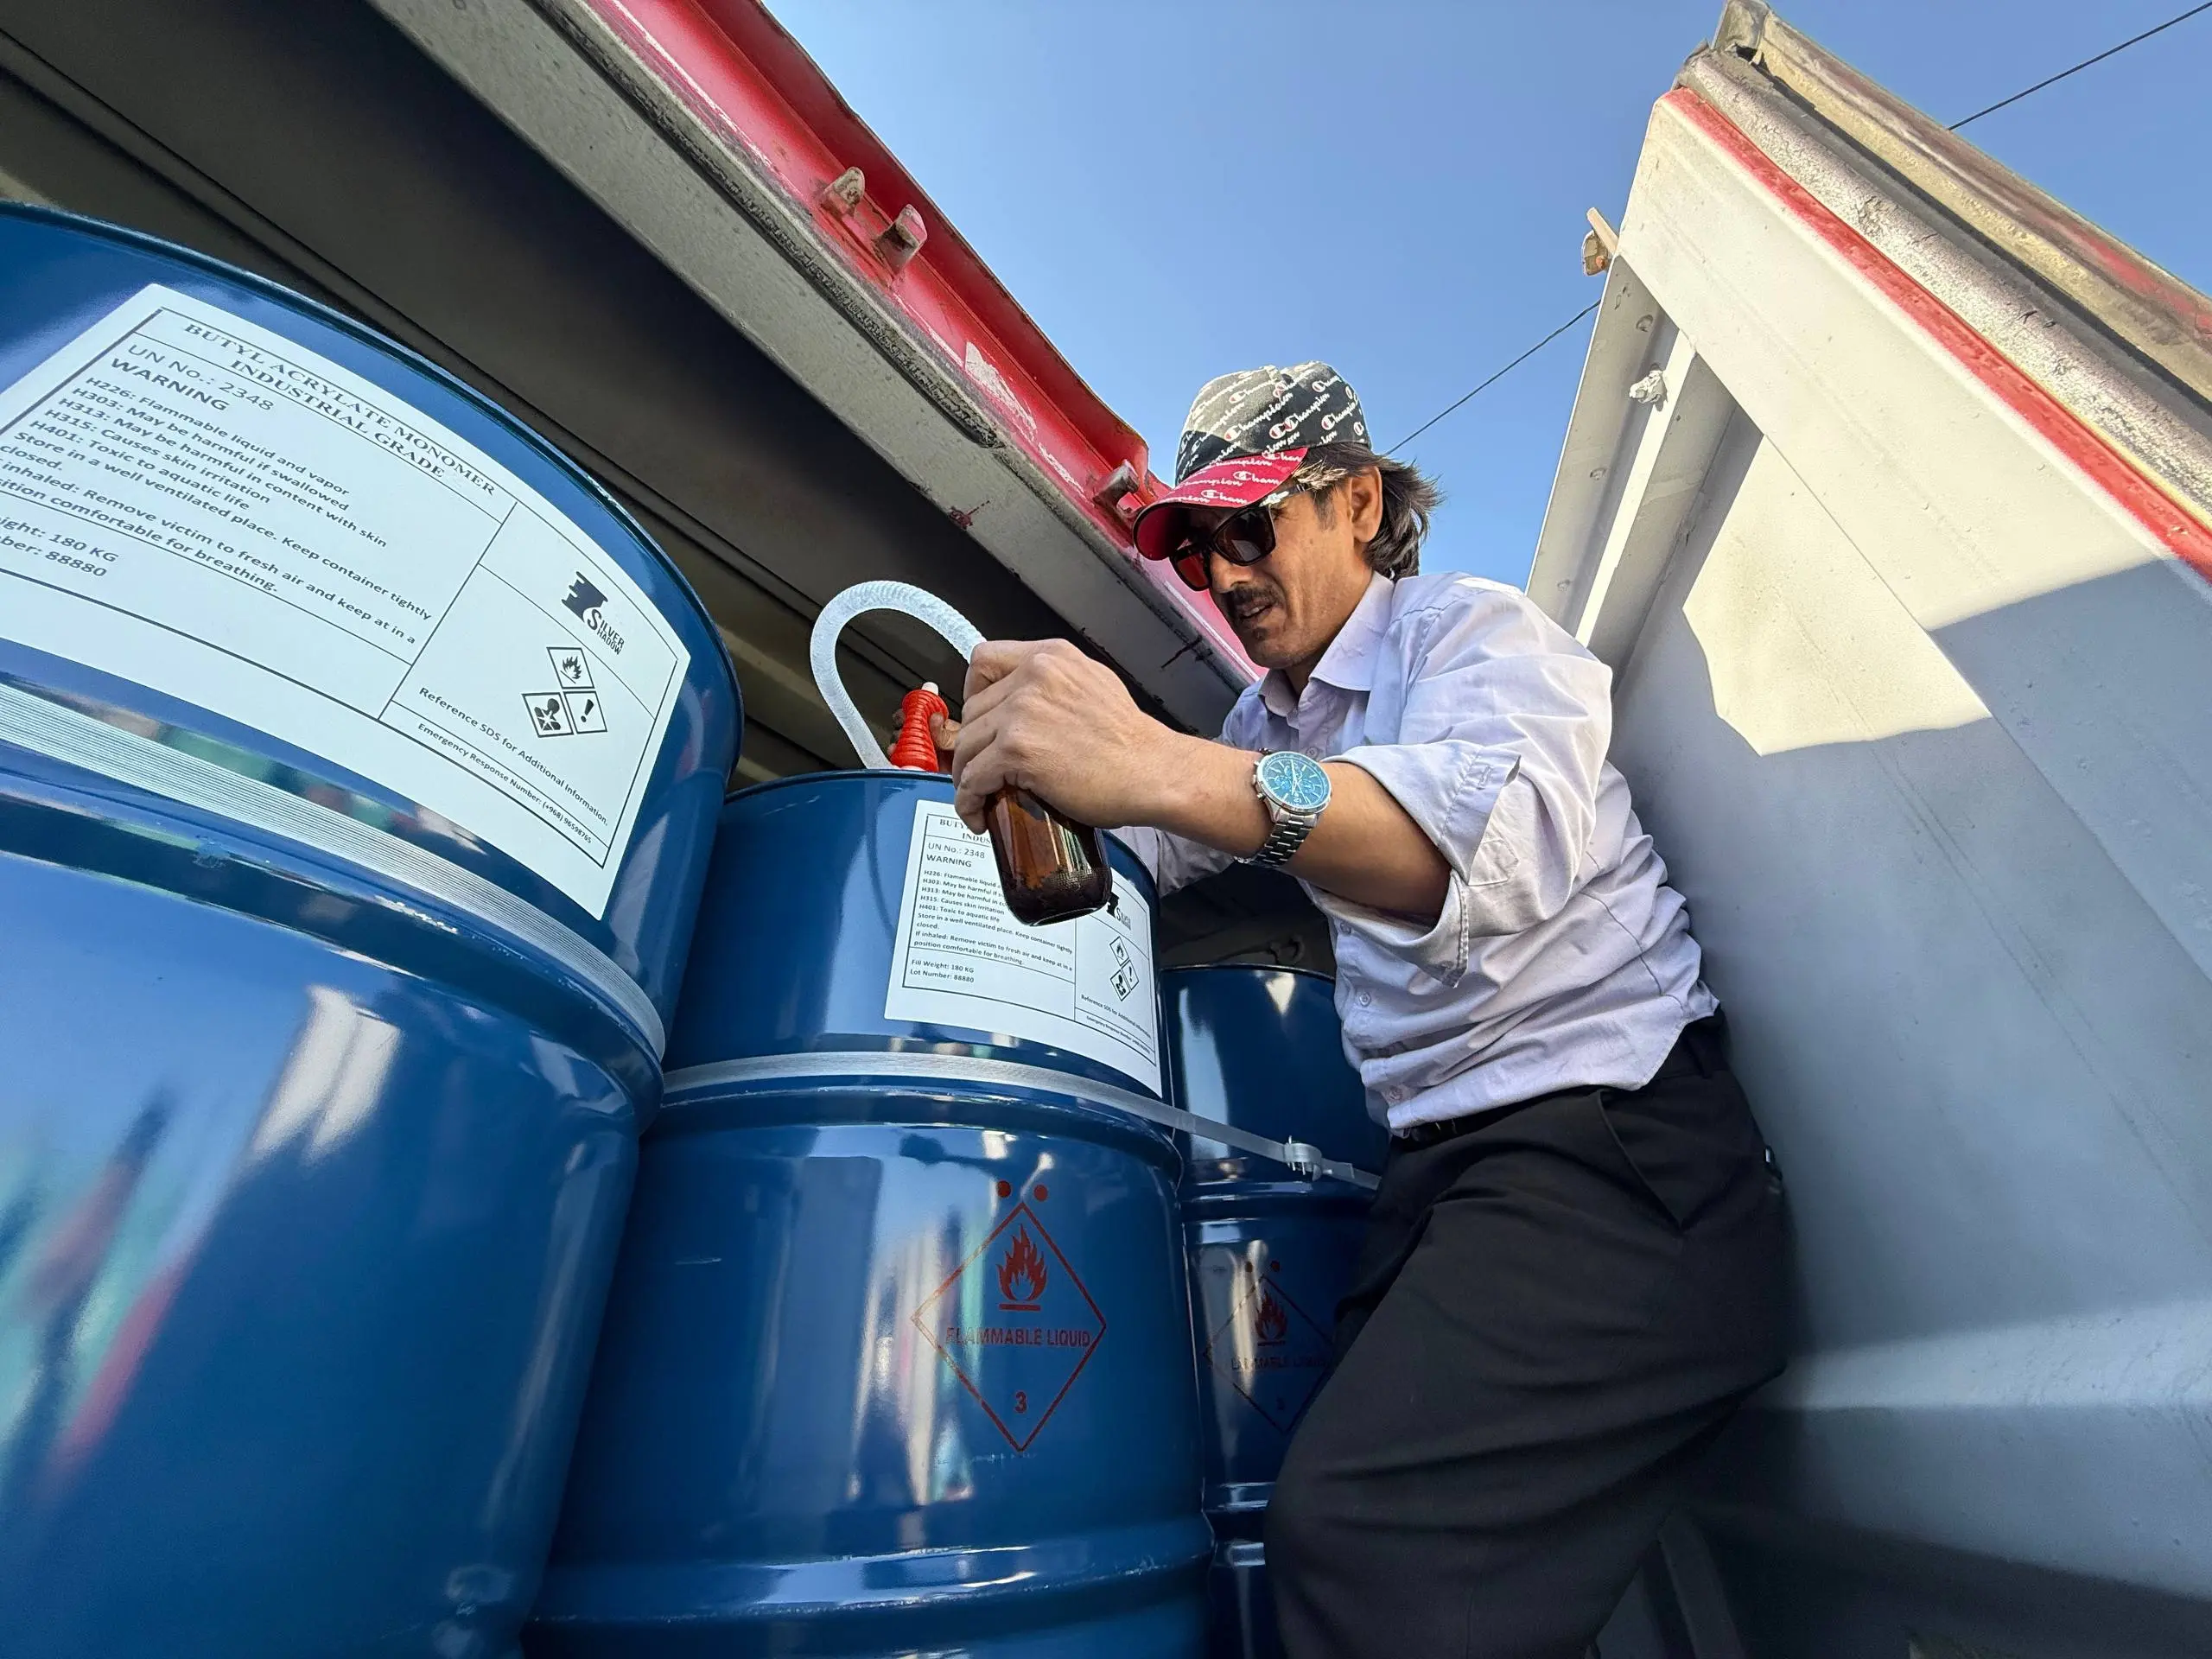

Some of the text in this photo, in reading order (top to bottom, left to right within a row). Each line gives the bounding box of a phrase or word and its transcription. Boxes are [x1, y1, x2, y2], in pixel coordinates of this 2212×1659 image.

[111, 358, 231, 411] WARNING
[128, 345, 274, 411] UN No.: 2348
[183, 324, 496, 496] BUTYL ACRYLATE MONOMER
[230, 360, 445, 478] INDUSTRIAL GRADE
[44, 409, 270, 503] H315: Causes skin irritation
[72, 388, 350, 512] H303: May be harmful if swallowed
[86, 377, 350, 496] H226: Flammable liquid and vapor
[29, 420, 250, 510] H401: Toxic to aquatic life
[58, 398, 387, 548] H313: May be harmful in content with skin
[14, 432, 65, 453] Store
[67, 449, 86, 461] in
[104, 463, 144, 481] well
[144, 479, 232, 518] ventilated
[231, 515, 277, 540] place.
[282, 537, 320, 561] Keep
[321, 558, 389, 595] container
[390, 593, 432, 620] tightly
[50, 497, 162, 542] comfortable
[165, 537, 194, 553] for
[194, 549, 277, 592] breathing.
[2, 461, 416, 645] inhaled: Remove victim to fresh air and keep at in a
[44, 550, 108, 577] 88880
[48, 533, 87, 550] 180
[89, 547, 119, 563] KG
[419, 687, 608, 826] Reference SDS for Additional Information.
[418, 722, 592, 843] Emergency Response Number: (+968) 96598765
[926, 854, 972, 868] WARNING
[927, 842, 942, 851] UN
[963, 848, 985, 859] 2348
[942, 889, 957, 898] May
[967, 893, 991, 904] harmful
[943, 880, 957, 889] May
[967, 884, 992, 895] harmful
[944, 872, 978, 884] Flammable
[979, 877, 996, 888] liquid
[940, 897, 963, 906] Causes
[977, 904, 1005, 915] irritation
[966, 912, 988, 921] aquatic
[913, 940, 941, 949] position
[942, 944, 982, 956] comfortable
[950, 935, 976, 944] Remove
[977, 940, 997, 949] victim
[1006, 945, 1021, 955] fresh
[964, 918, 996, 931] ventilated
[1015, 931, 1030, 939] Keep
[1046, 1328, 1091, 1348] LIQUID
[1014, 1391, 1028, 1414] 3
